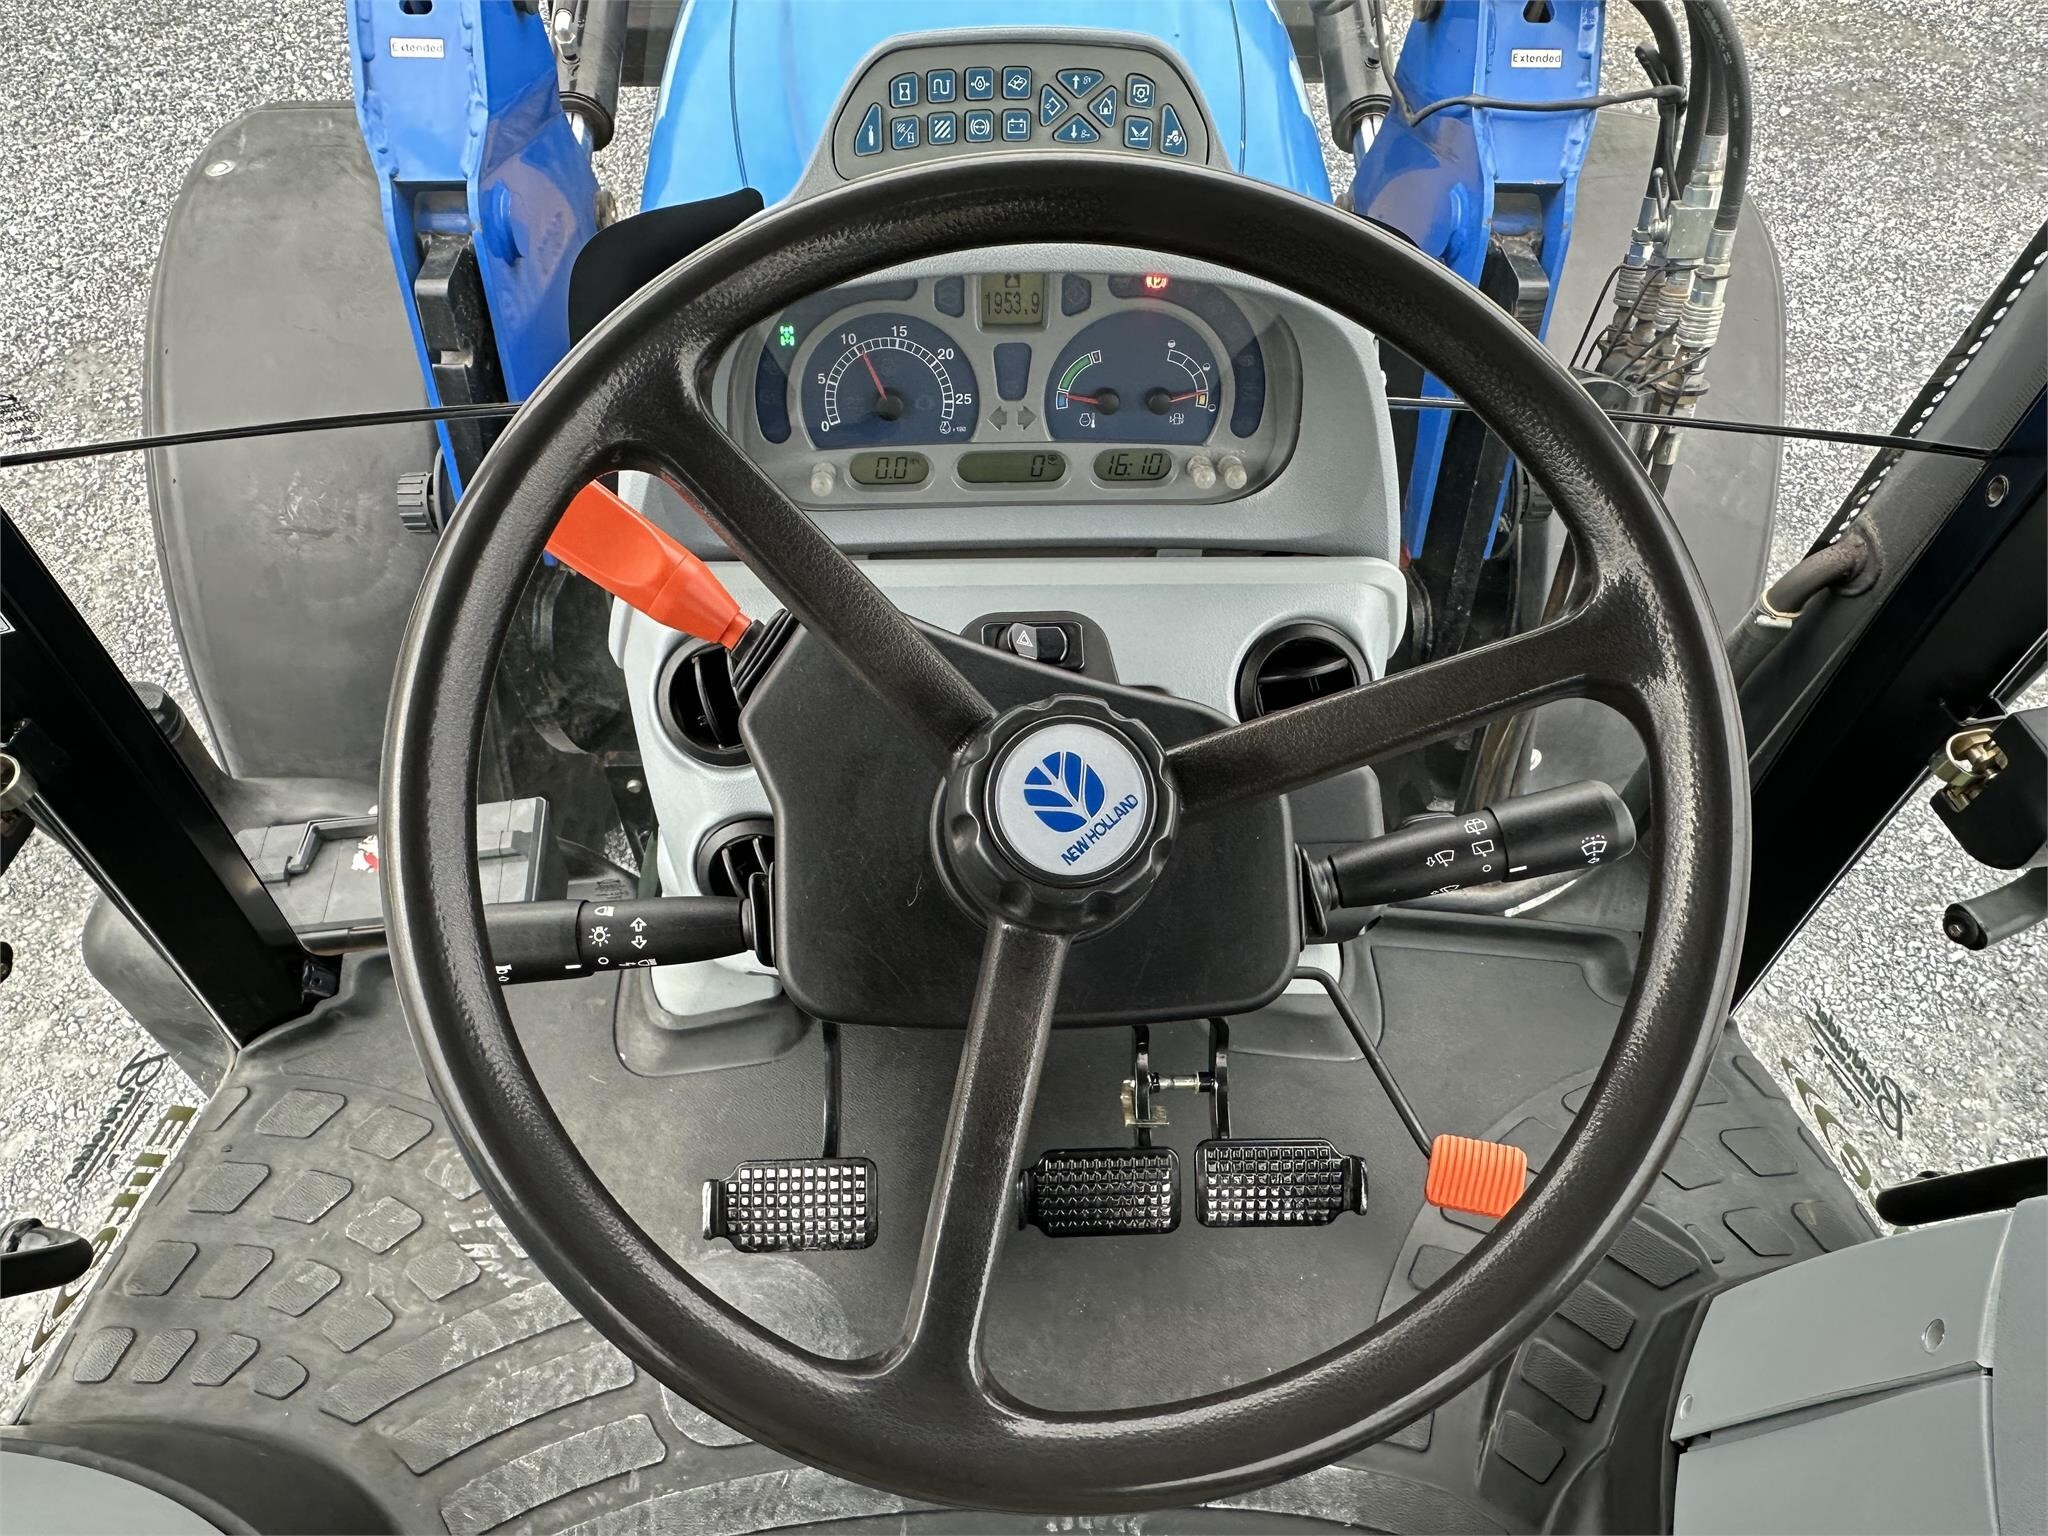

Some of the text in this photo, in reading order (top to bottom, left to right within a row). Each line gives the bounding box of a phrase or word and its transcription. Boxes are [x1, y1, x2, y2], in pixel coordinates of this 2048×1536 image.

[392, 42, 443, 53] Extended
[1512, 53, 1561, 63] Extended
[984, 291, 1040, 316] 1953.9
[891, 325, 908, 337] 15
[841, 333, 857, 345] 10
[937, 349, 954, 361] 20
[817, 373, 825, 385] 5
[955, 394, 972, 405] 25
[820, 420, 830, 432] 0
[874, 456, 908, 480] 0.0
[1108, 453, 1163, 476] 16:10
[1061, 794, 1139, 866] NEW HOLLAND
